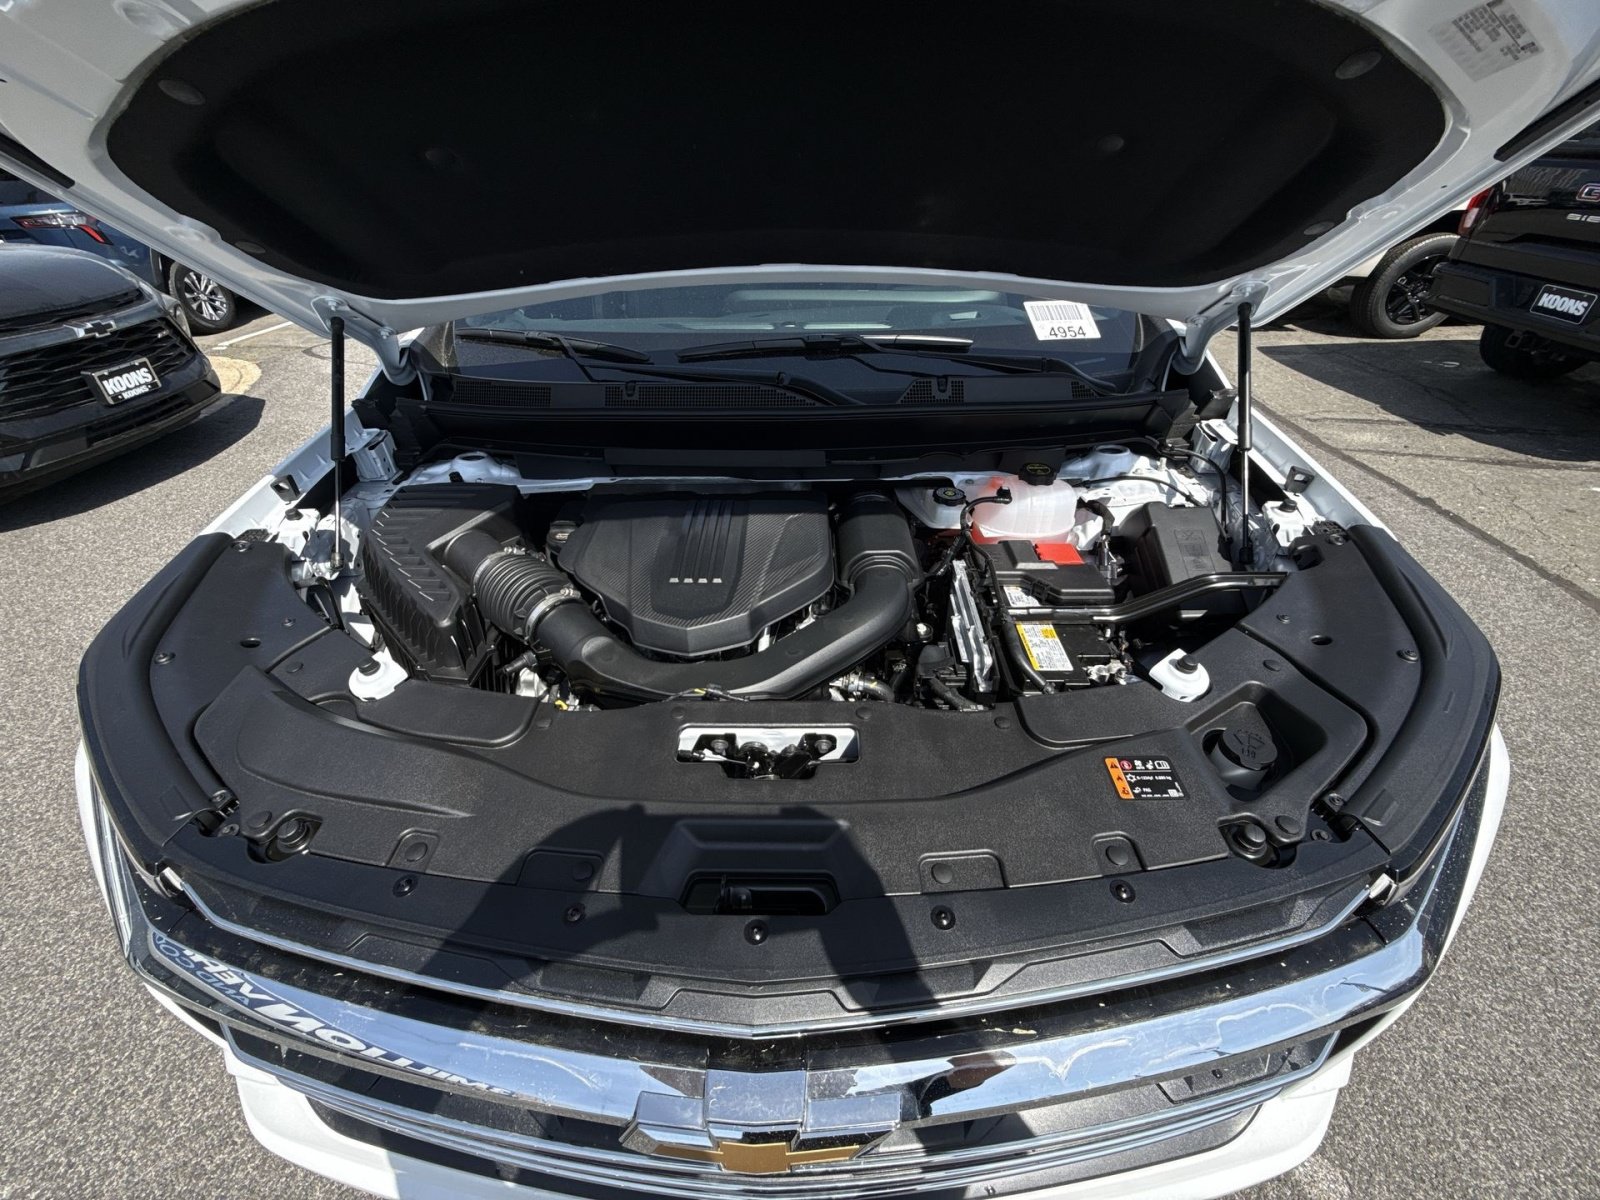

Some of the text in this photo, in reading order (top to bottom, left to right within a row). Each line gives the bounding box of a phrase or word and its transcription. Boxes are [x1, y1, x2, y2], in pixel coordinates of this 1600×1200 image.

[1537, 292, 1589, 316] KOONS
[1049, 325, 1087, 338] 4954
[102, 367, 153, 395] KOONS
